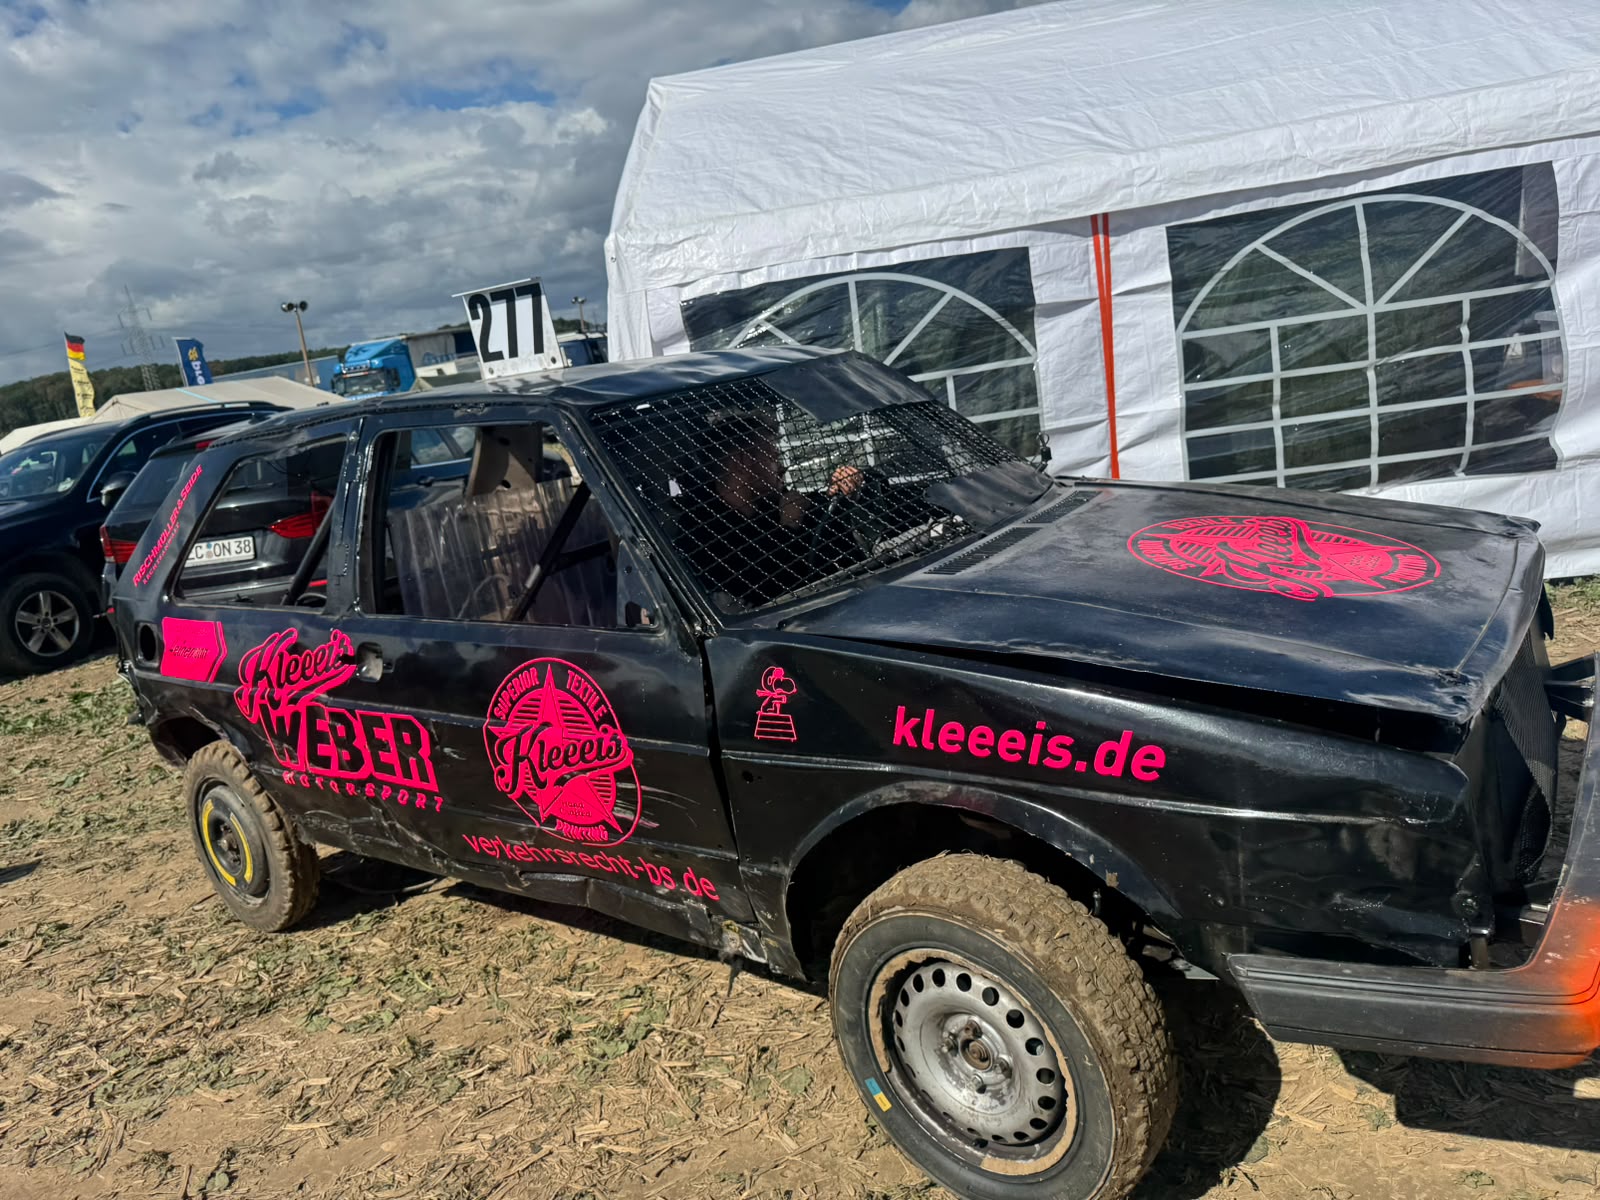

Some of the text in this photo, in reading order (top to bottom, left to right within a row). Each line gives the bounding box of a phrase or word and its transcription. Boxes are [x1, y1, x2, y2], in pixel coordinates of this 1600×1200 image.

[468, 283, 544, 362] 277
[234, 539, 252, 554] 38
[1137, 539, 1196, 570] SUPERIOR
[493, 667, 541, 721] SUPERIOR
[565, 669, 609, 723] TEXTILE
[259, 702, 440, 792] WEBER
[494, 720, 633, 796] Kleeeis
[892, 705, 1166, 782] kleeeis.de
[281, 770, 444, 813] MOTORSPORT
[555, 819, 609, 841] PRINTING
[462, 833, 720, 901] verkehrsrecht-bs.de
